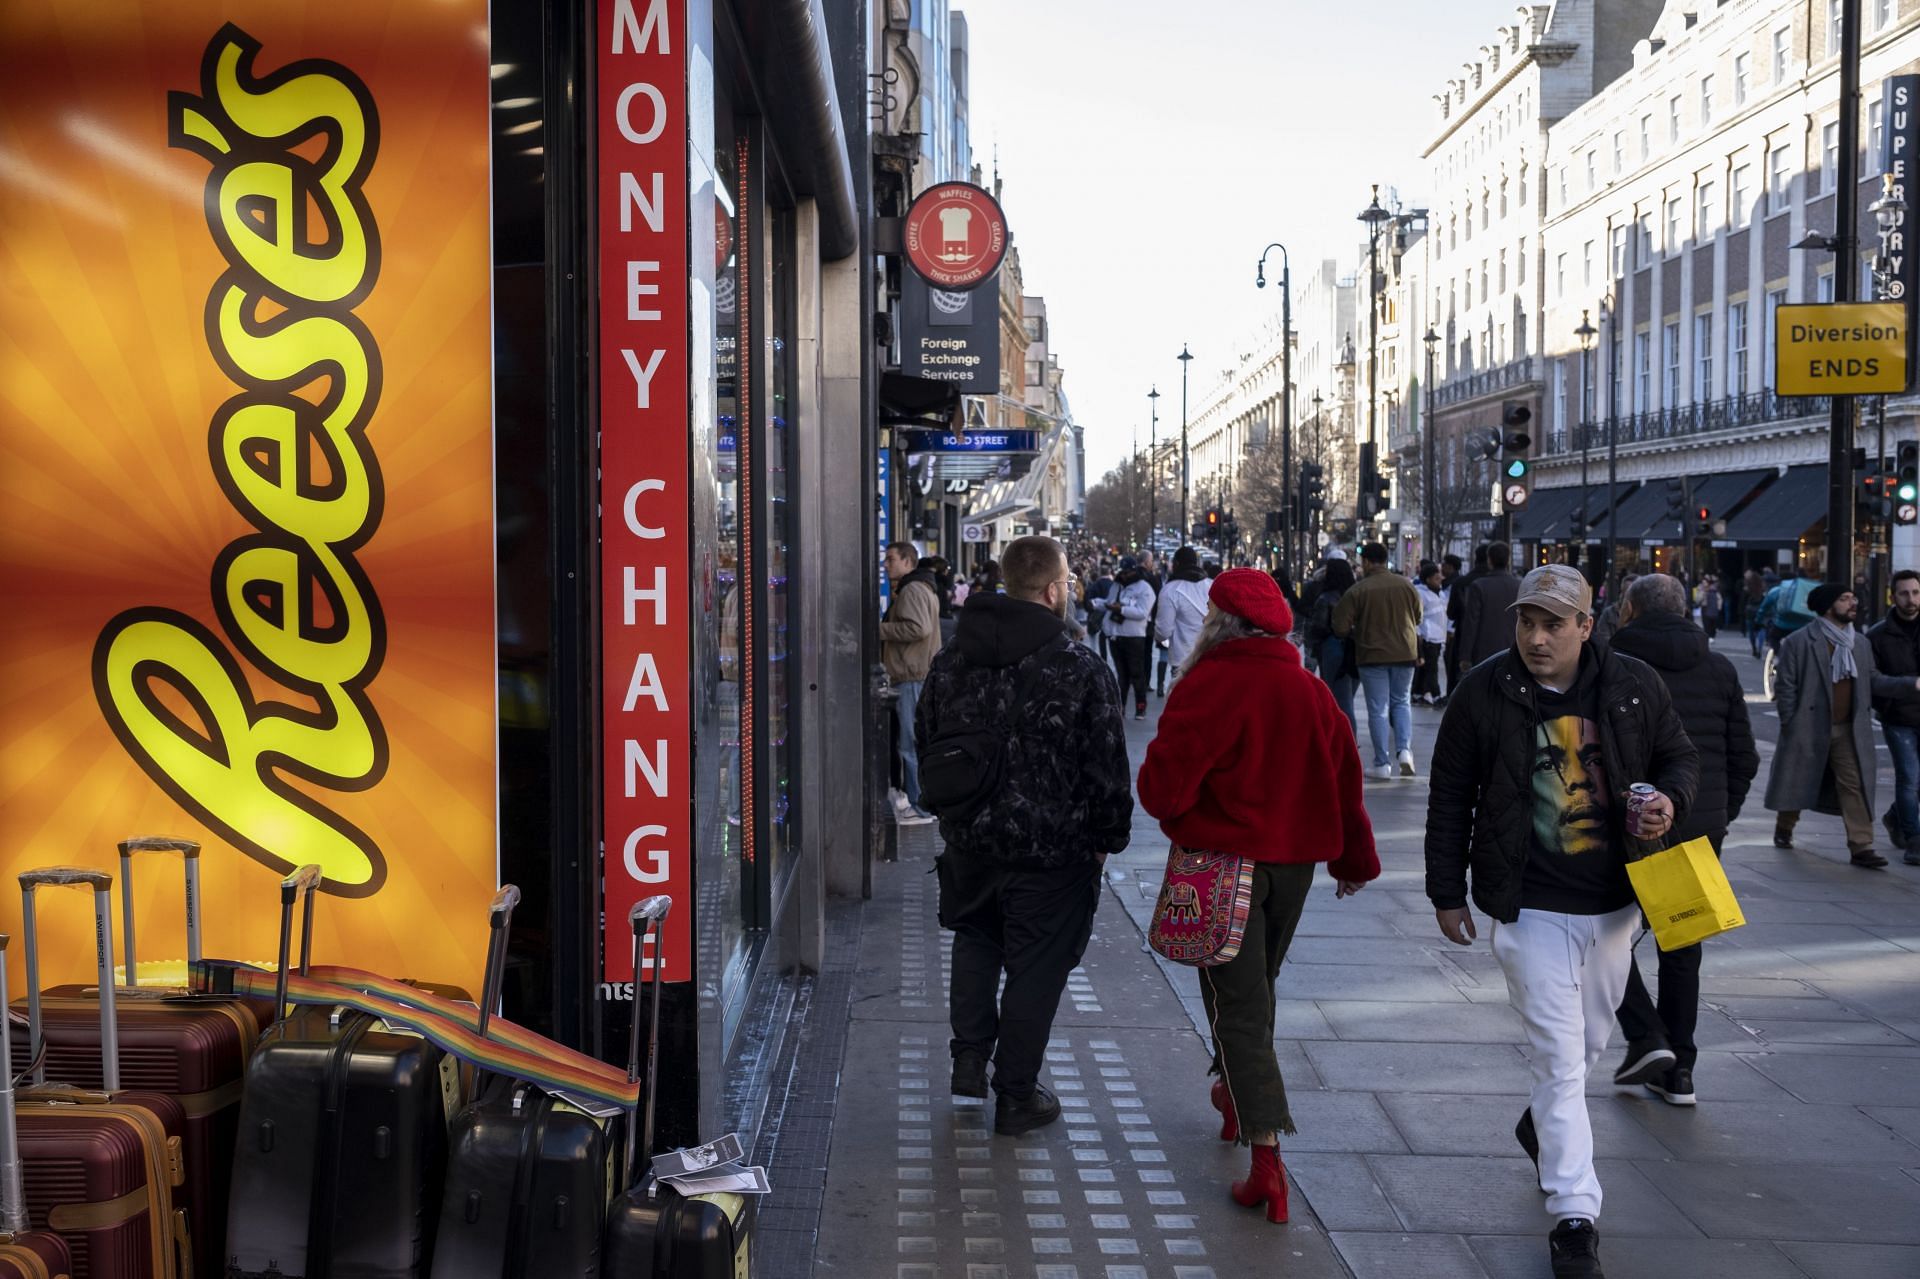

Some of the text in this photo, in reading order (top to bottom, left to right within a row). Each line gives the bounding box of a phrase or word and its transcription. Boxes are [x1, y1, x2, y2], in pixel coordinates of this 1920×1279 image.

[612, 0, 671, 408] MONEY
[939, 189, 972, 200] WAFFLES
[909, 222, 918, 251] COFFEE
[992, 221, 1001, 252] GELATO
[930, 269, 982, 282] THICK SHAKES
[1791, 323, 1898, 343] Diversion
[921, 338, 966, 350] Foreign
[921, 354, 980, 366] Exchange
[1810, 358, 1880, 377] ENDS
[922, 369, 974, 380] Services
[943, 436, 1008, 445] BOD STREET
[92, 21, 389, 898] Reese's
[96, 913, 104, 968] SWISSPORT
